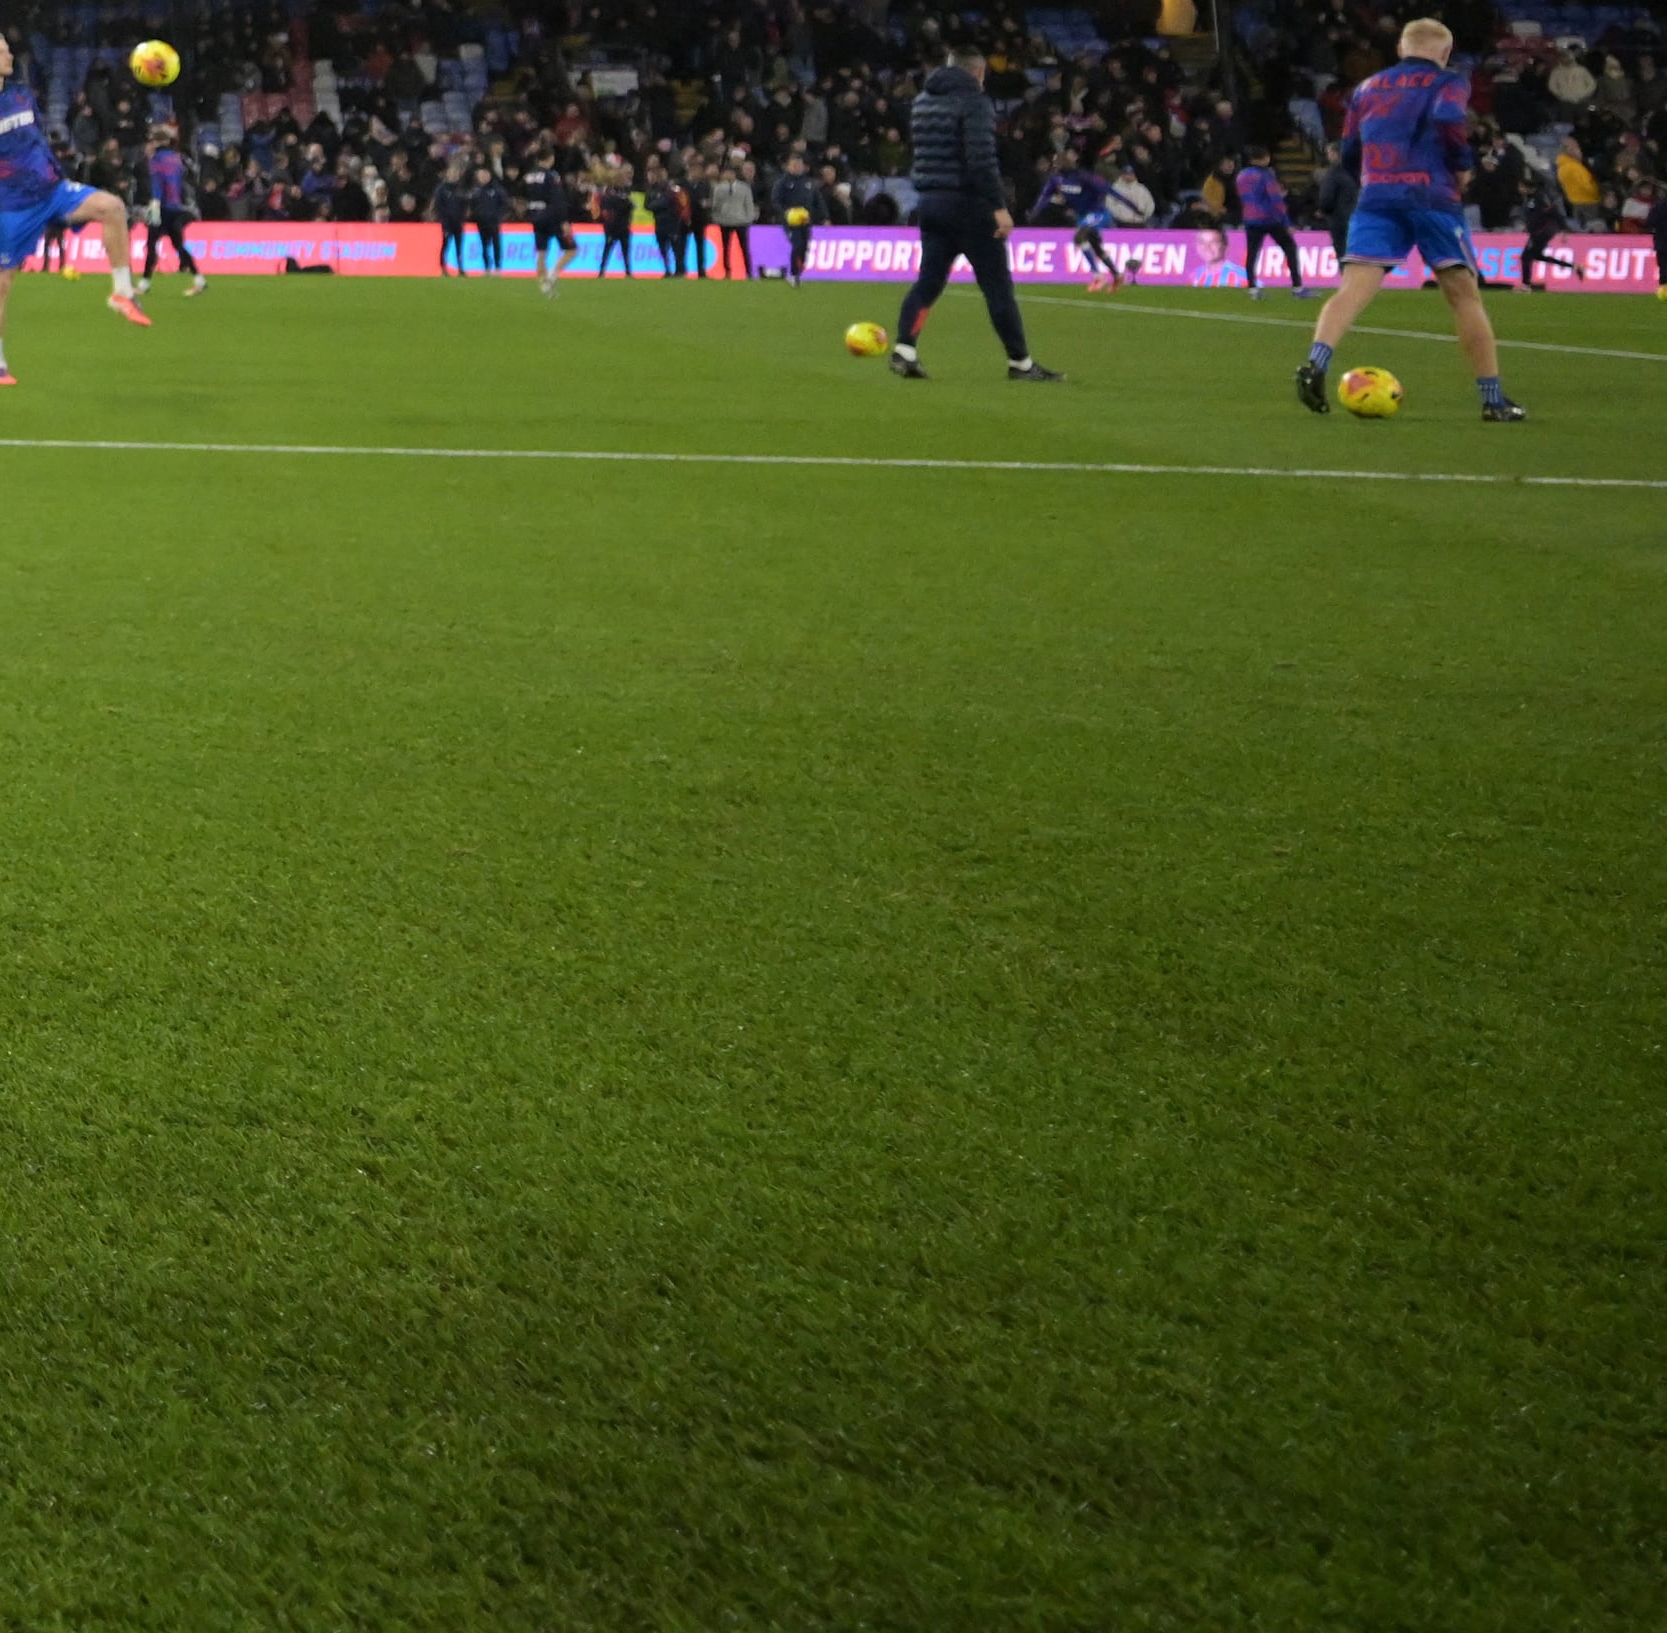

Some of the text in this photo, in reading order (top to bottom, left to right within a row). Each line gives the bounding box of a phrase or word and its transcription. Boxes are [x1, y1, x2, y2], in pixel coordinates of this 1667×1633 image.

[211, 240, 315, 259] COMMUNITY
[320, 241, 397, 259] STADIUM
[1586, 248, 1659, 280] SUT
